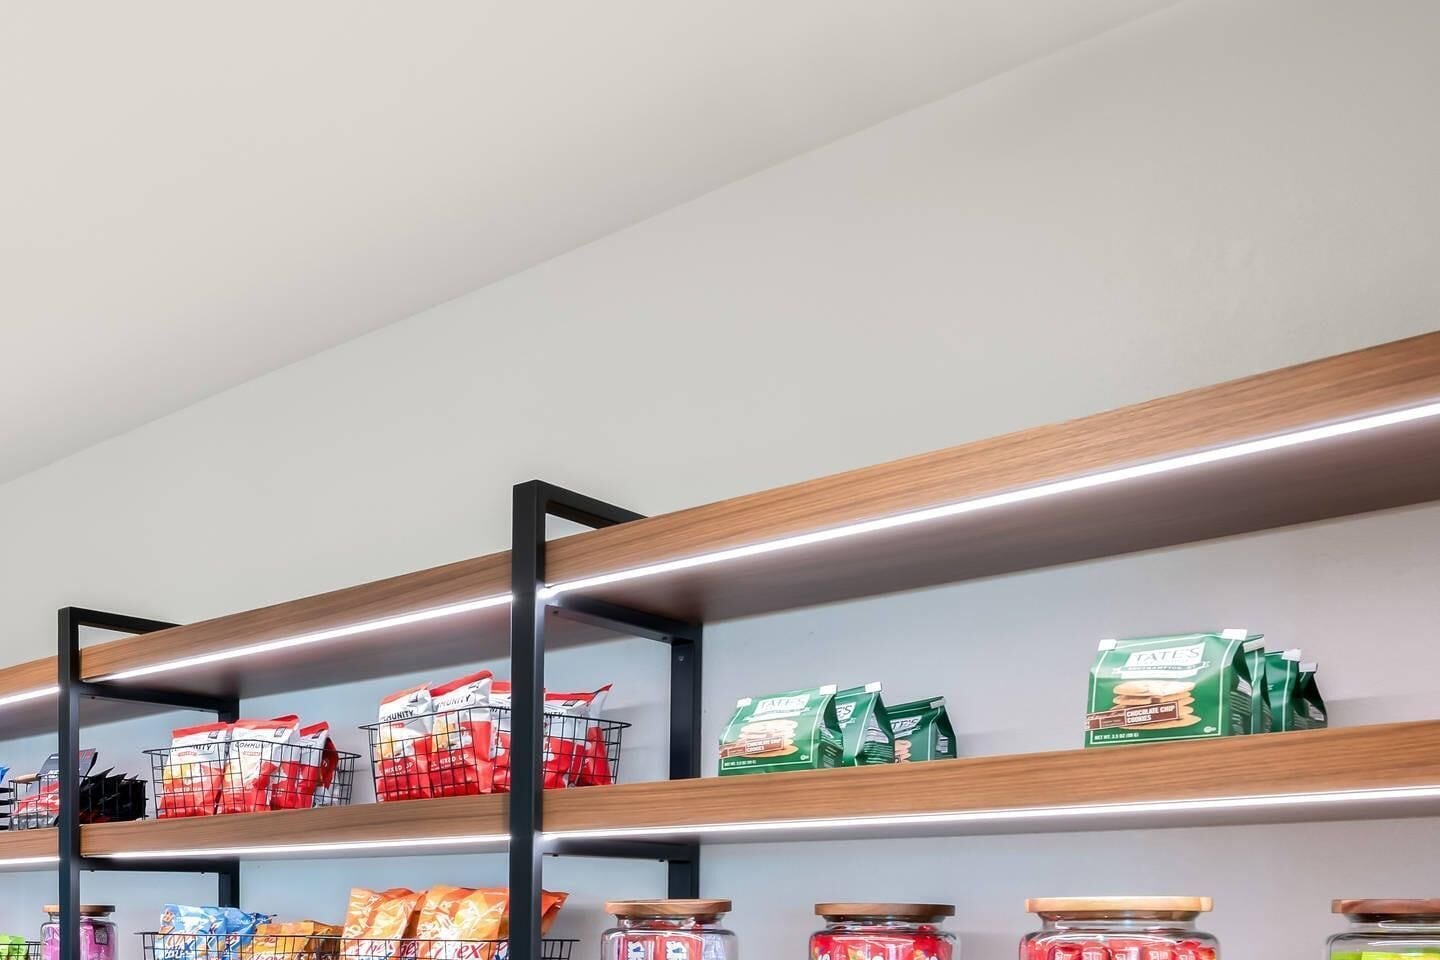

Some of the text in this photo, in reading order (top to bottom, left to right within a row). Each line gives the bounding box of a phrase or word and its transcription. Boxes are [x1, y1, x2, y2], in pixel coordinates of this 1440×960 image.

[1132, 646, 1201, 663] TATE'S
[1126, 703, 1175, 718] CHOCOLATE CHIP
[1126, 713, 1152, 725] COOKIES
